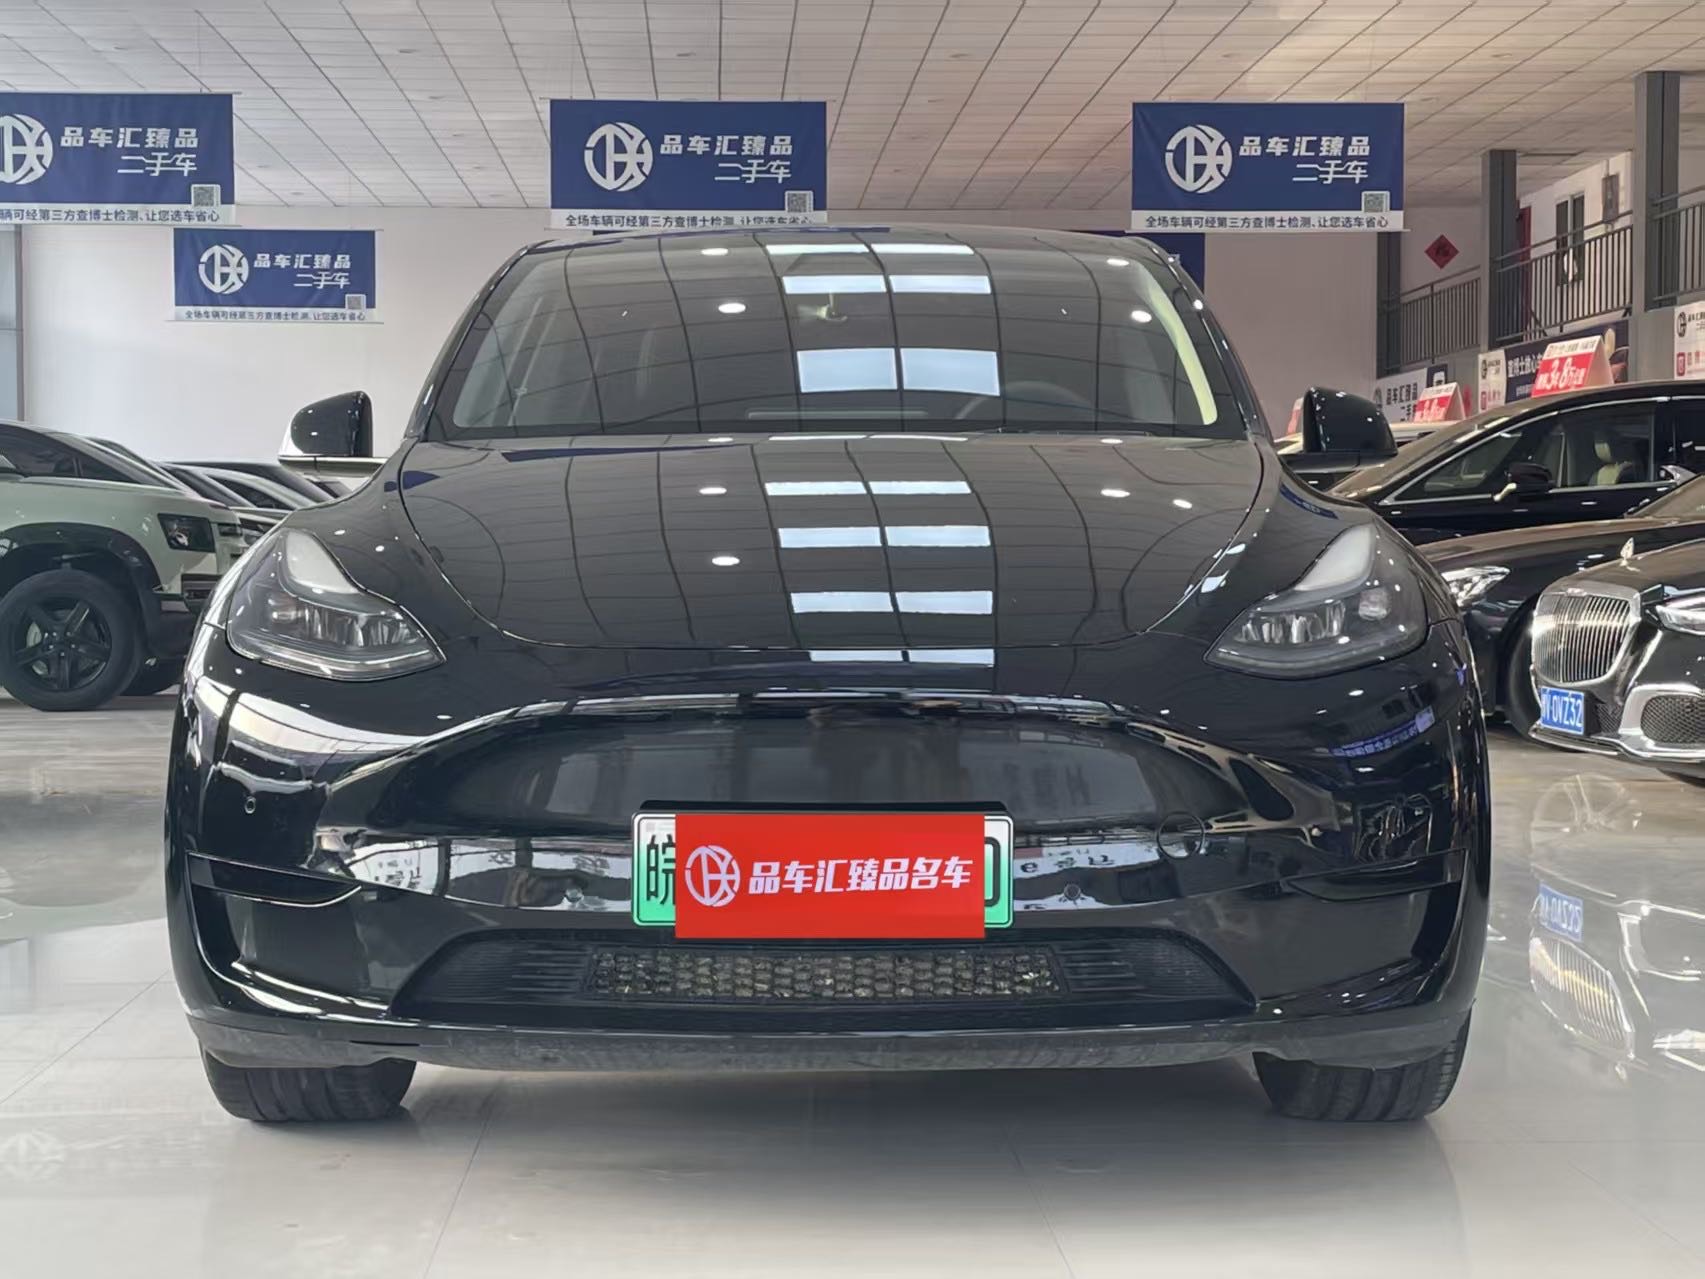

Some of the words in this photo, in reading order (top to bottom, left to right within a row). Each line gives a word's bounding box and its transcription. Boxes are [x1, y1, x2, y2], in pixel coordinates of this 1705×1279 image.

[61, 127, 198, 148] 品车汇臻品
[660, 135, 793, 156] 品车汇臻品
[1239, 136, 1370, 157] 品车汇臻品
[117, 153, 197, 176] 二手车
[714, 160, 791, 184] 二手车
[1292, 160, 1369, 184] 二手车
[253, 253, 351, 269] 品车汇臻品
[294, 271, 350, 289] 二手车
